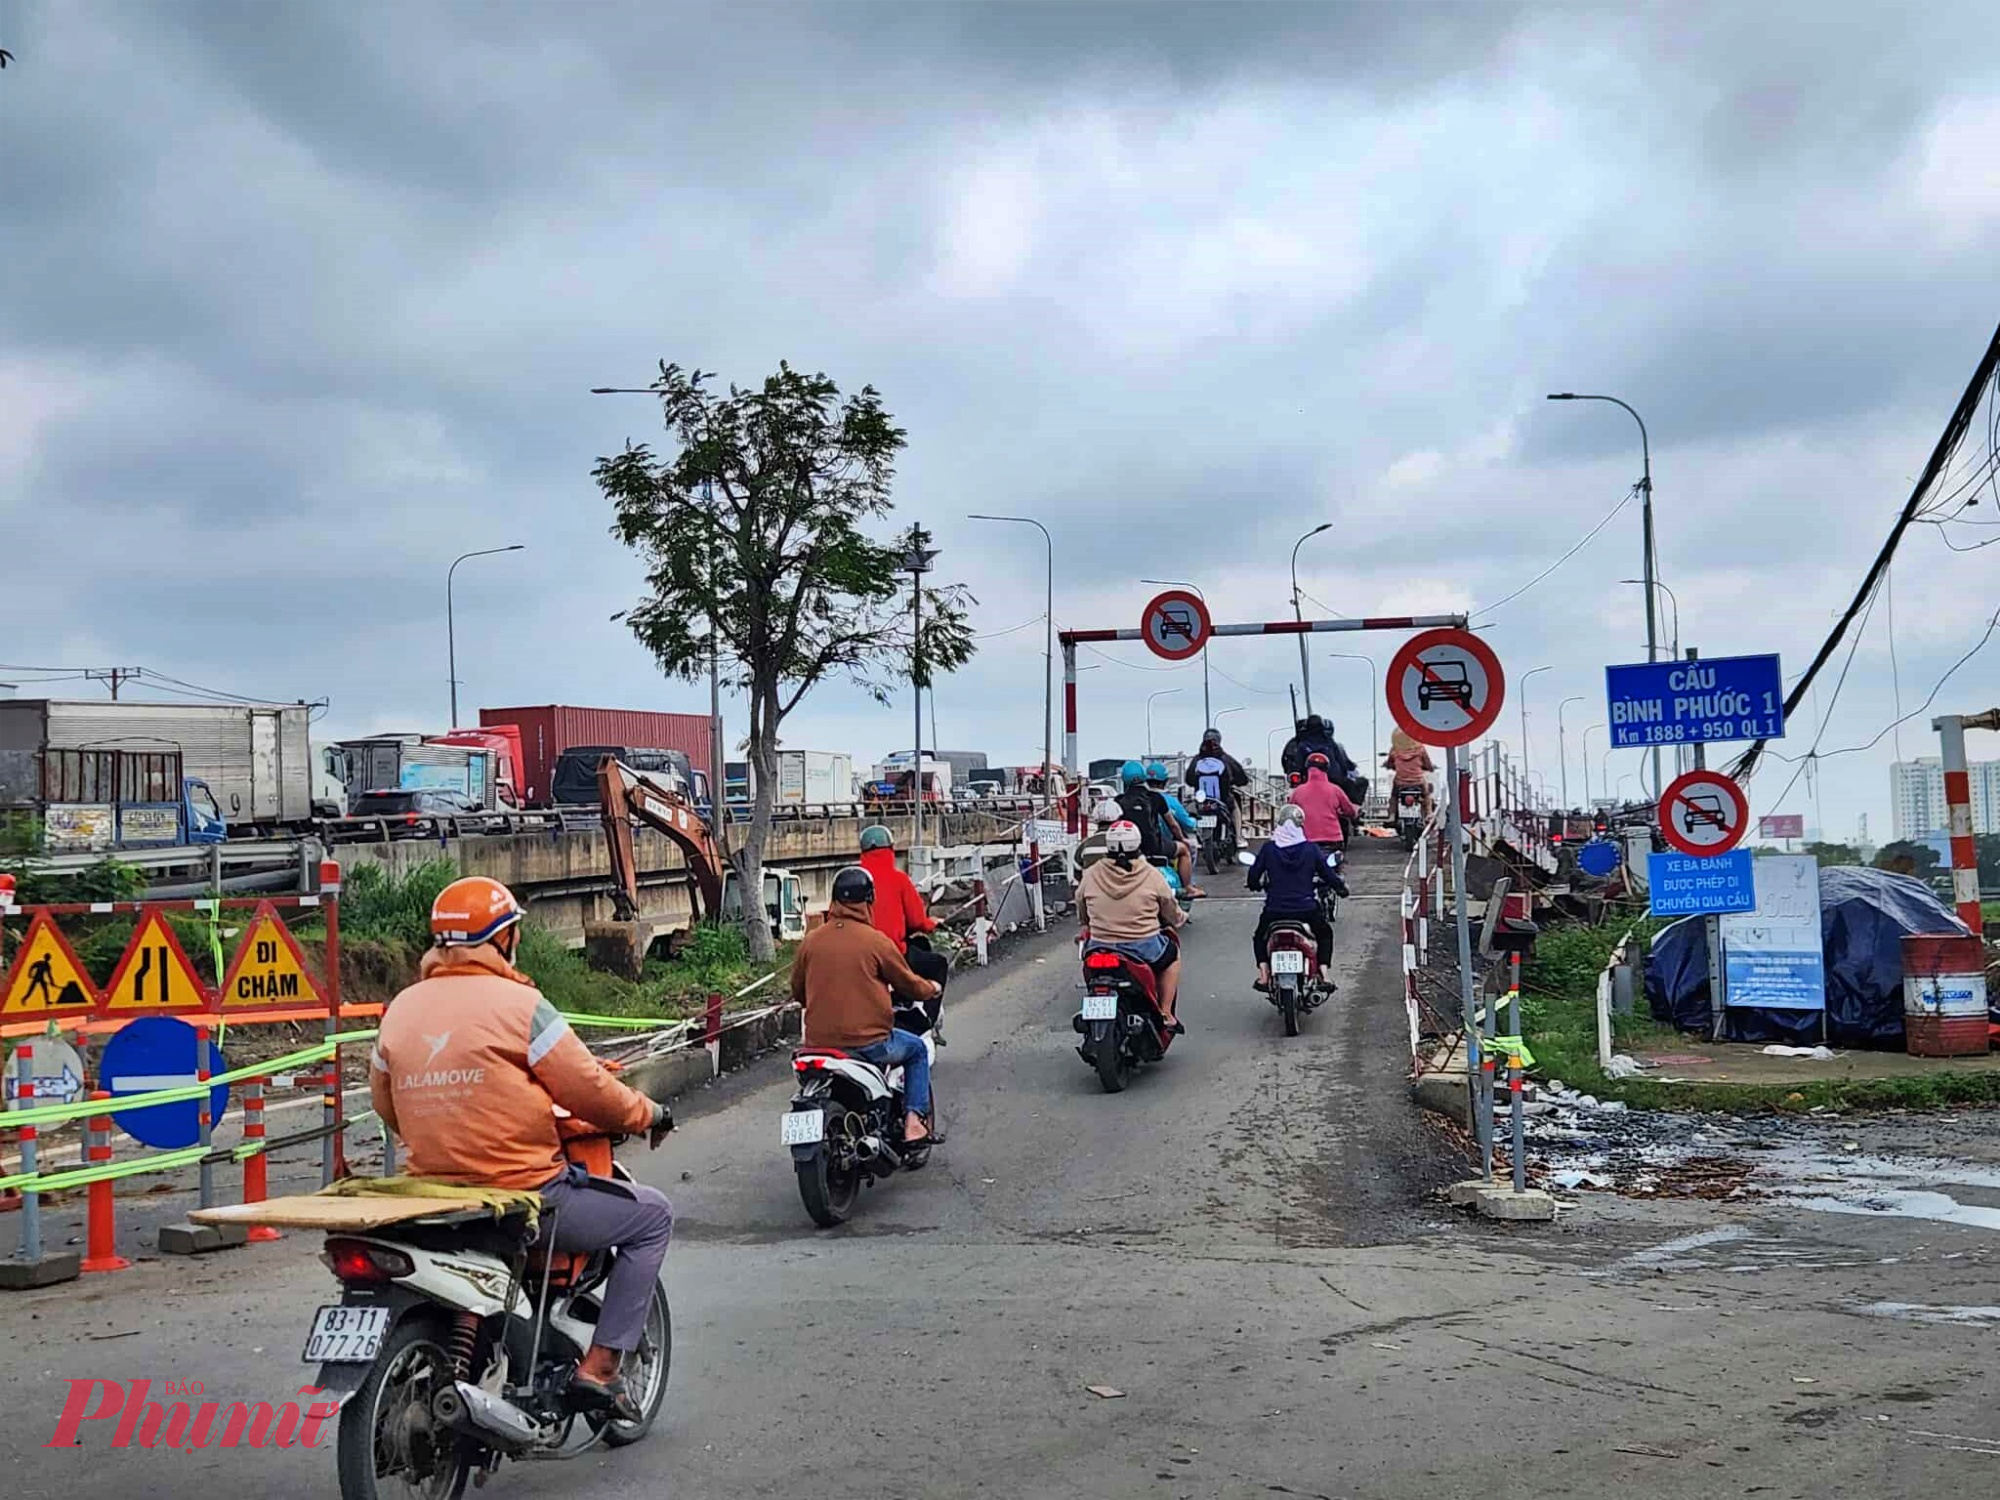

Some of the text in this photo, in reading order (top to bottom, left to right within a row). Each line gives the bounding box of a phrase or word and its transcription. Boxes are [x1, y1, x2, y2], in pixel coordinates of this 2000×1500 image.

[1669, 663, 1716, 691] CẦU
[1612, 686, 1776, 724] BÌNH PHƯỚC 1
[1618, 718, 1776, 743] Km 1888 + 950 QL 1
[1666, 860, 1682, 872] XE
[1683, 859, 1699, 871] BA
[1696, 874, 1725, 889] PHÉP
[1702, 896, 1725, 908] QUA
[256, 941, 277, 963] ĐI
[237, 969, 299, 1002] CHẬM
[397, 1067, 486, 1090] LALAMOVE
